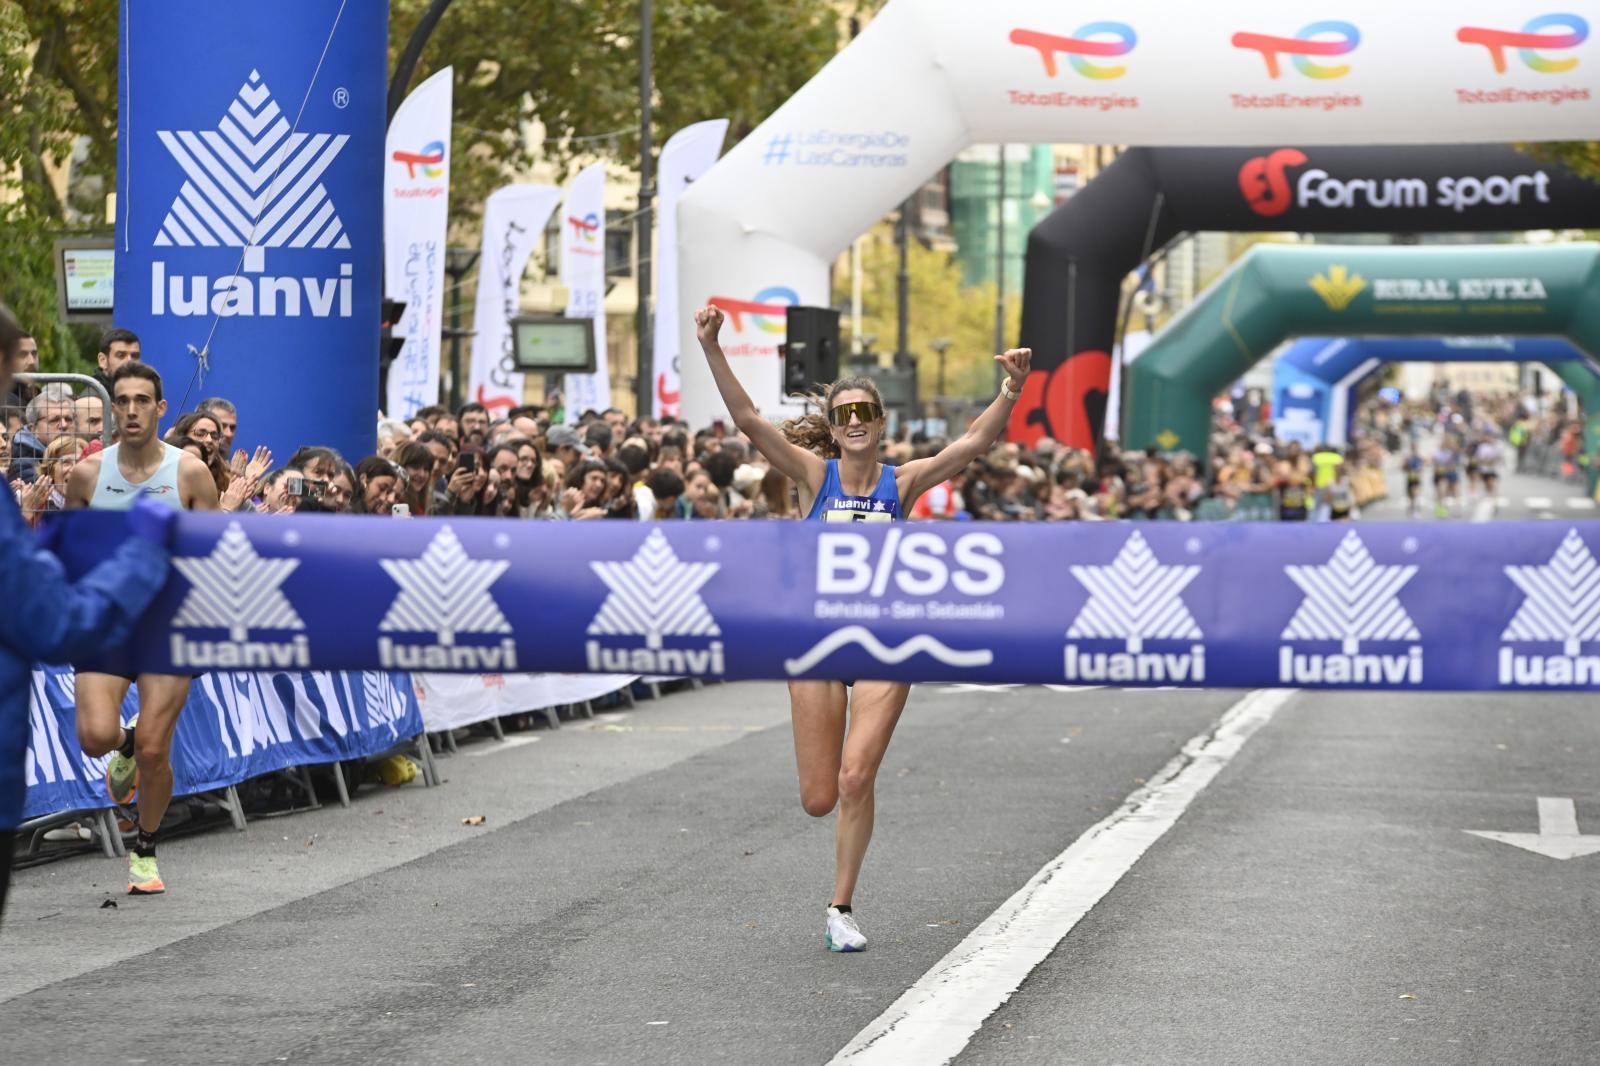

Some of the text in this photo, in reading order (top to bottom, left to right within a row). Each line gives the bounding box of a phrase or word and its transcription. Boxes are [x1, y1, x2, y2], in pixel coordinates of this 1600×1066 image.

[1008, 89, 1140, 112] TotalEnergies
[1230, 91, 1362, 112] TotalEnergies
[1454, 87, 1591, 107] TotalEnergies
[1298, 168, 1550, 213] forum sport
[151, 261, 353, 317] luanvi
[834, 498, 871, 510] luanvi
[814, 600, 881, 619] Behobia
[891, 600, 924, 619] San
[170, 631, 310, 668] luanvi
[378, 637, 518, 671] luanvi
[585, 640, 726, 674] luanvi
[1064, 643, 1206, 682] luanvi
[1279, 645, 1424, 684] luanvi
